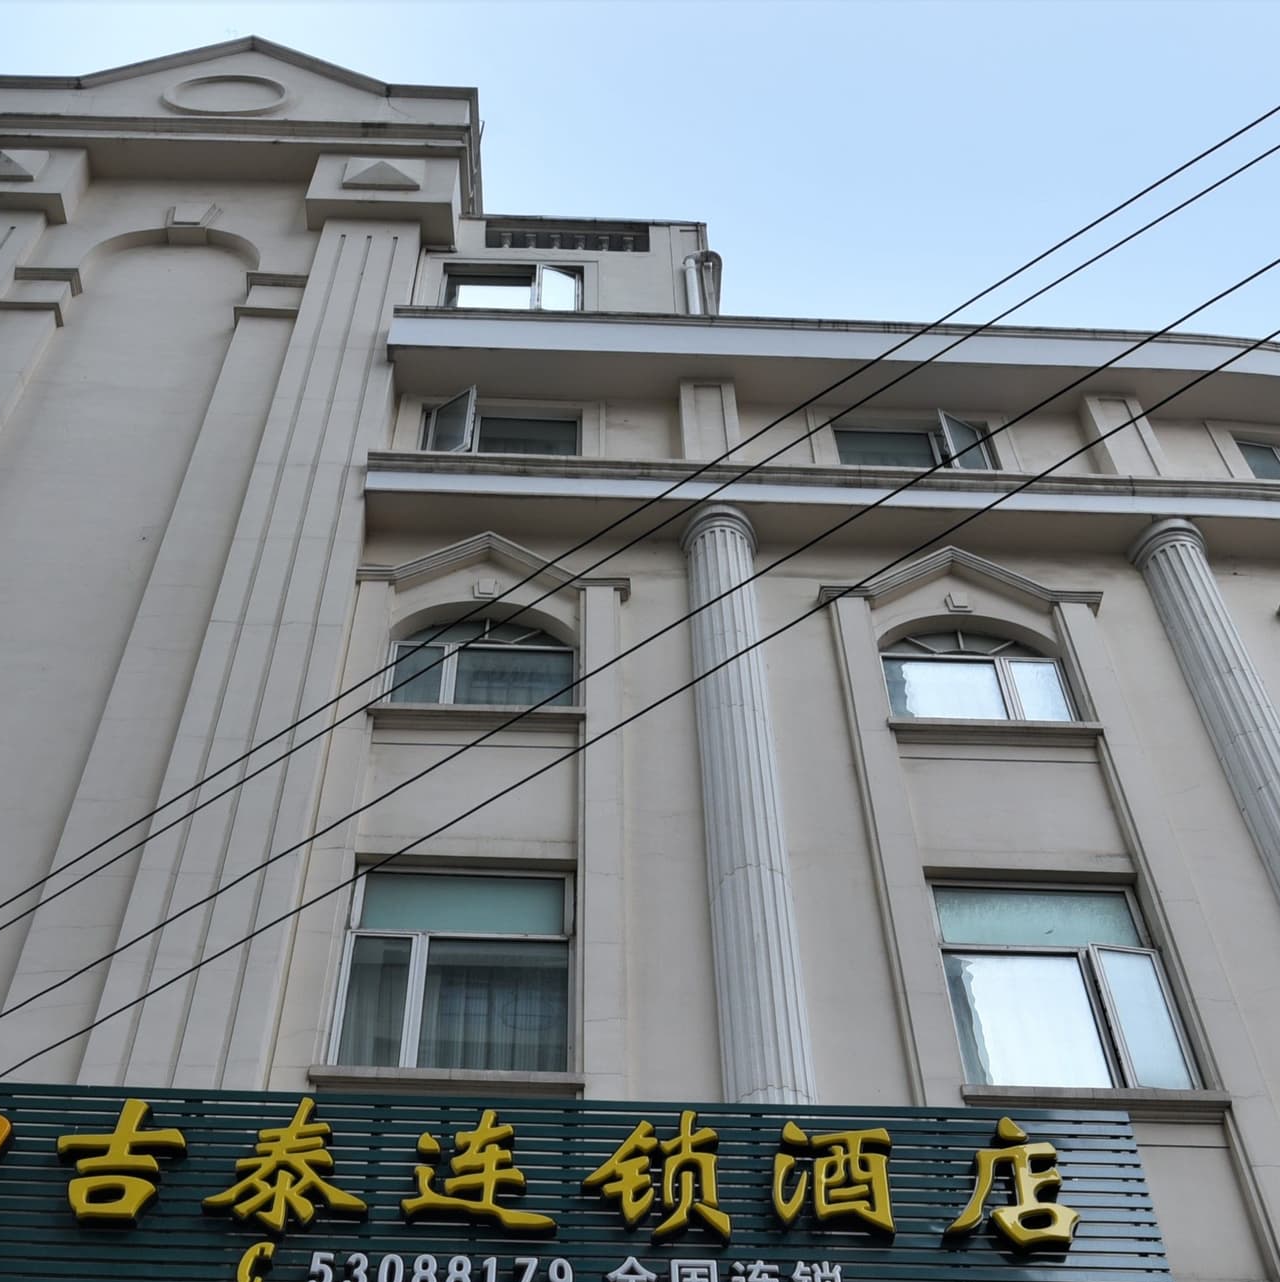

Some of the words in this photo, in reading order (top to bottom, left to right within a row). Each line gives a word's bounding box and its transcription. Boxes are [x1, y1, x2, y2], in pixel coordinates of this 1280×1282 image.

[57, 1097, 1080, 1252] 吉泰连锁酒店
